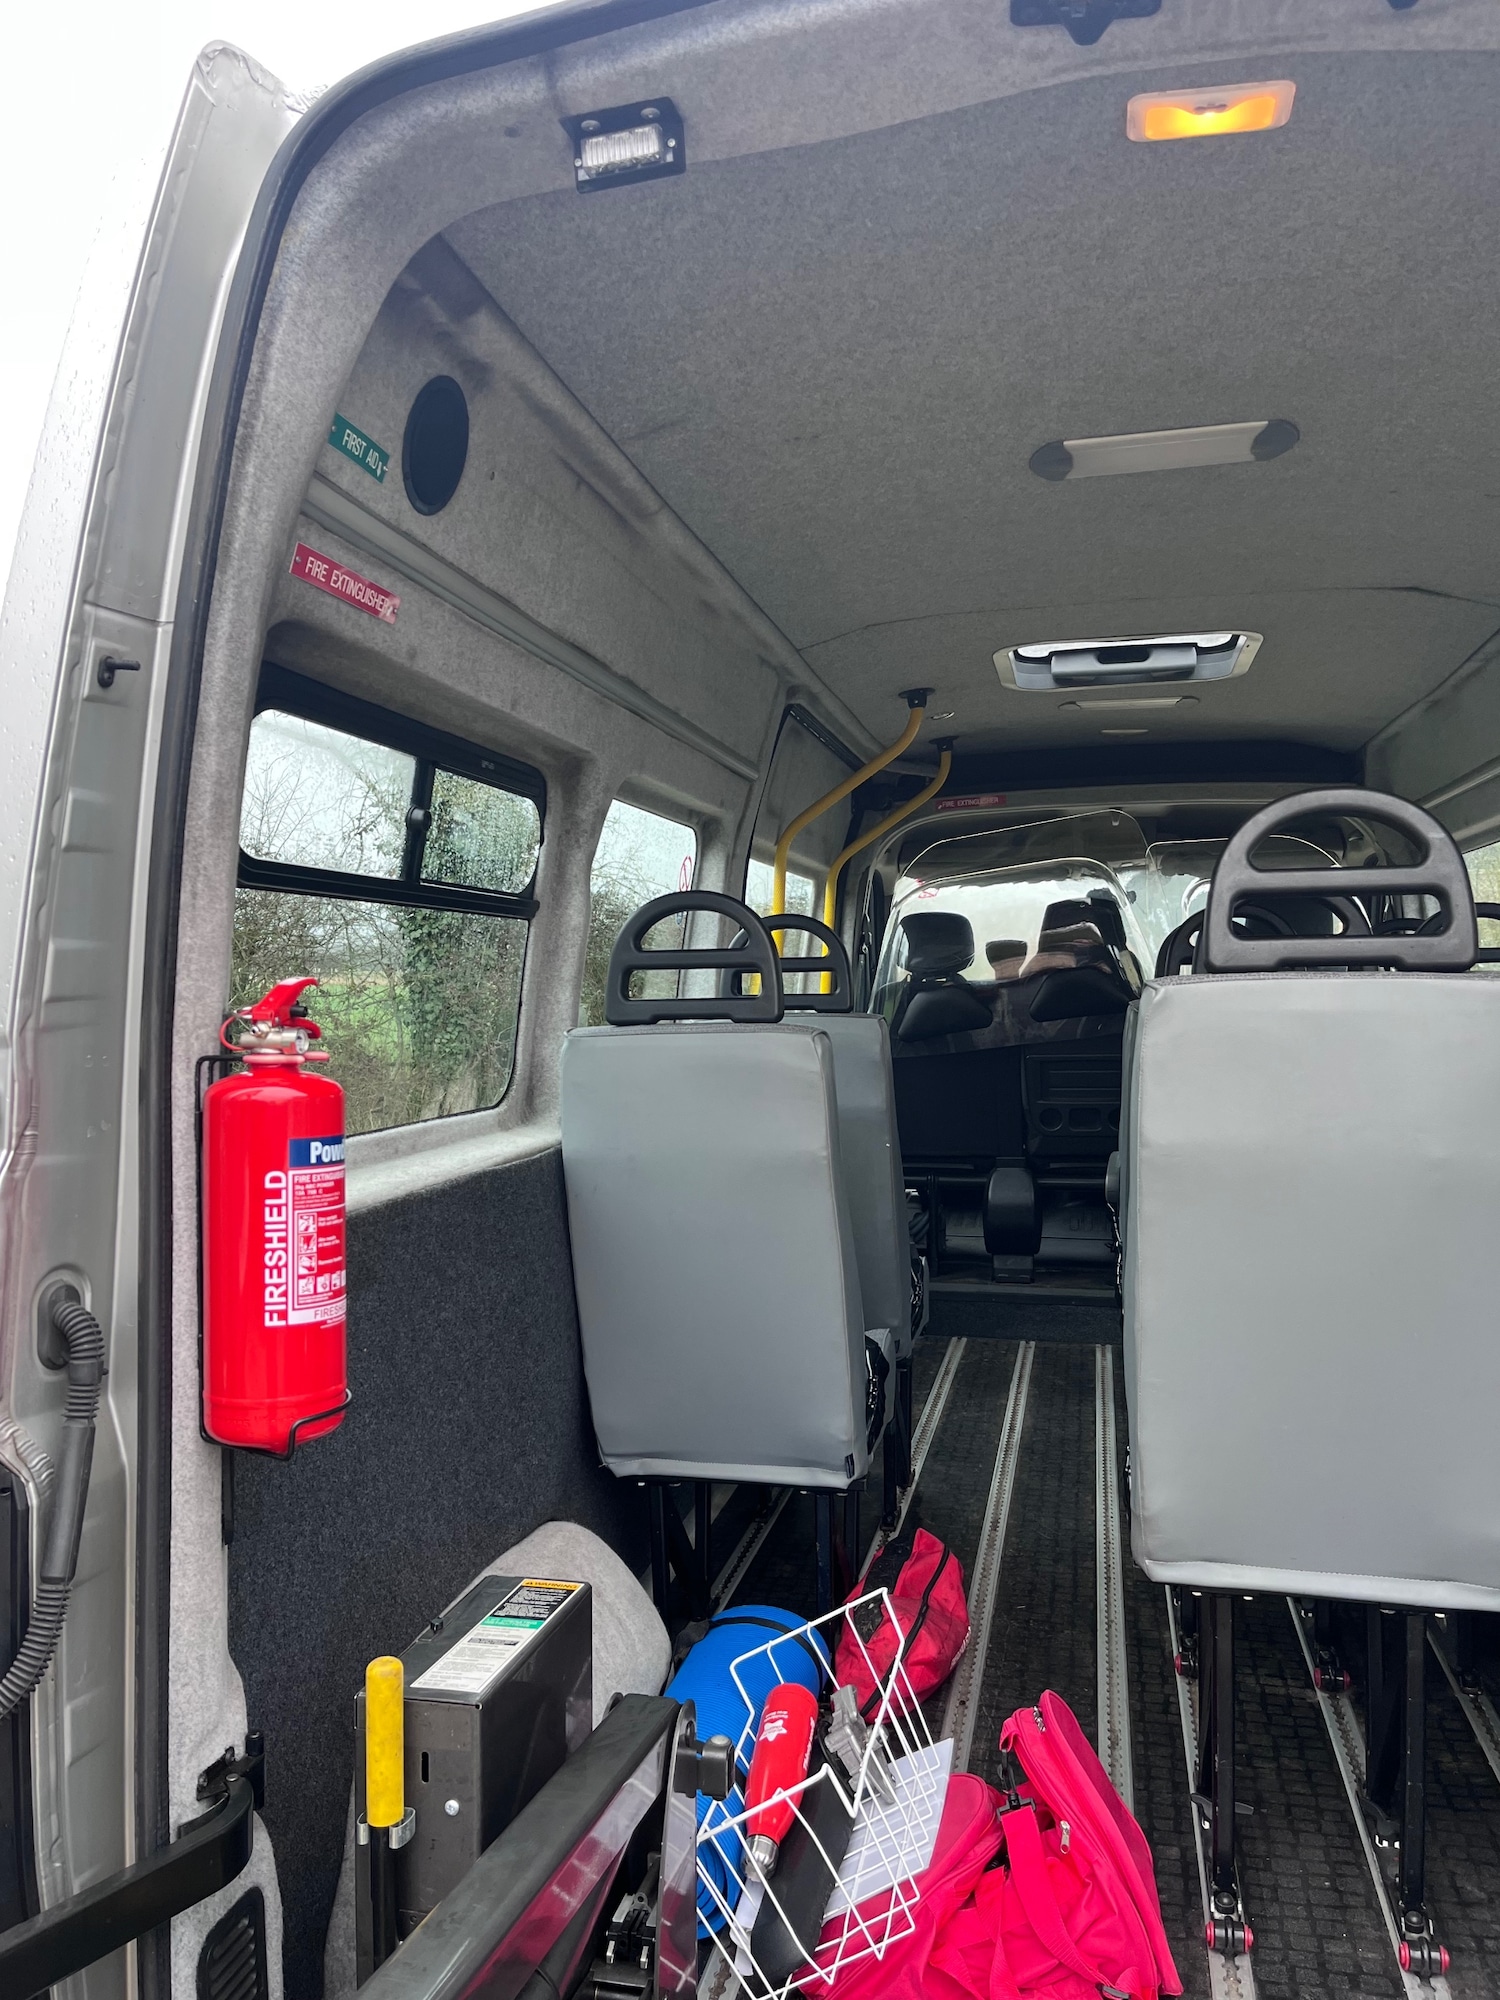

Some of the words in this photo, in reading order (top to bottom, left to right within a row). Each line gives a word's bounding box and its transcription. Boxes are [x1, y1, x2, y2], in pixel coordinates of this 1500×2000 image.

[342, 428, 368, 458] FIRST
[365, 450, 379, 470] AID
[305, 556, 329, 582] FIRE
[330, 569, 390, 614] EXTINGUISHER
[942, 800, 955, 808] FIRE
[957, 797, 999, 806] EXTINGUISHER
[294, 1174, 311, 1184] FIRE
[264, 1170, 287, 1327] FIRESHIELD
